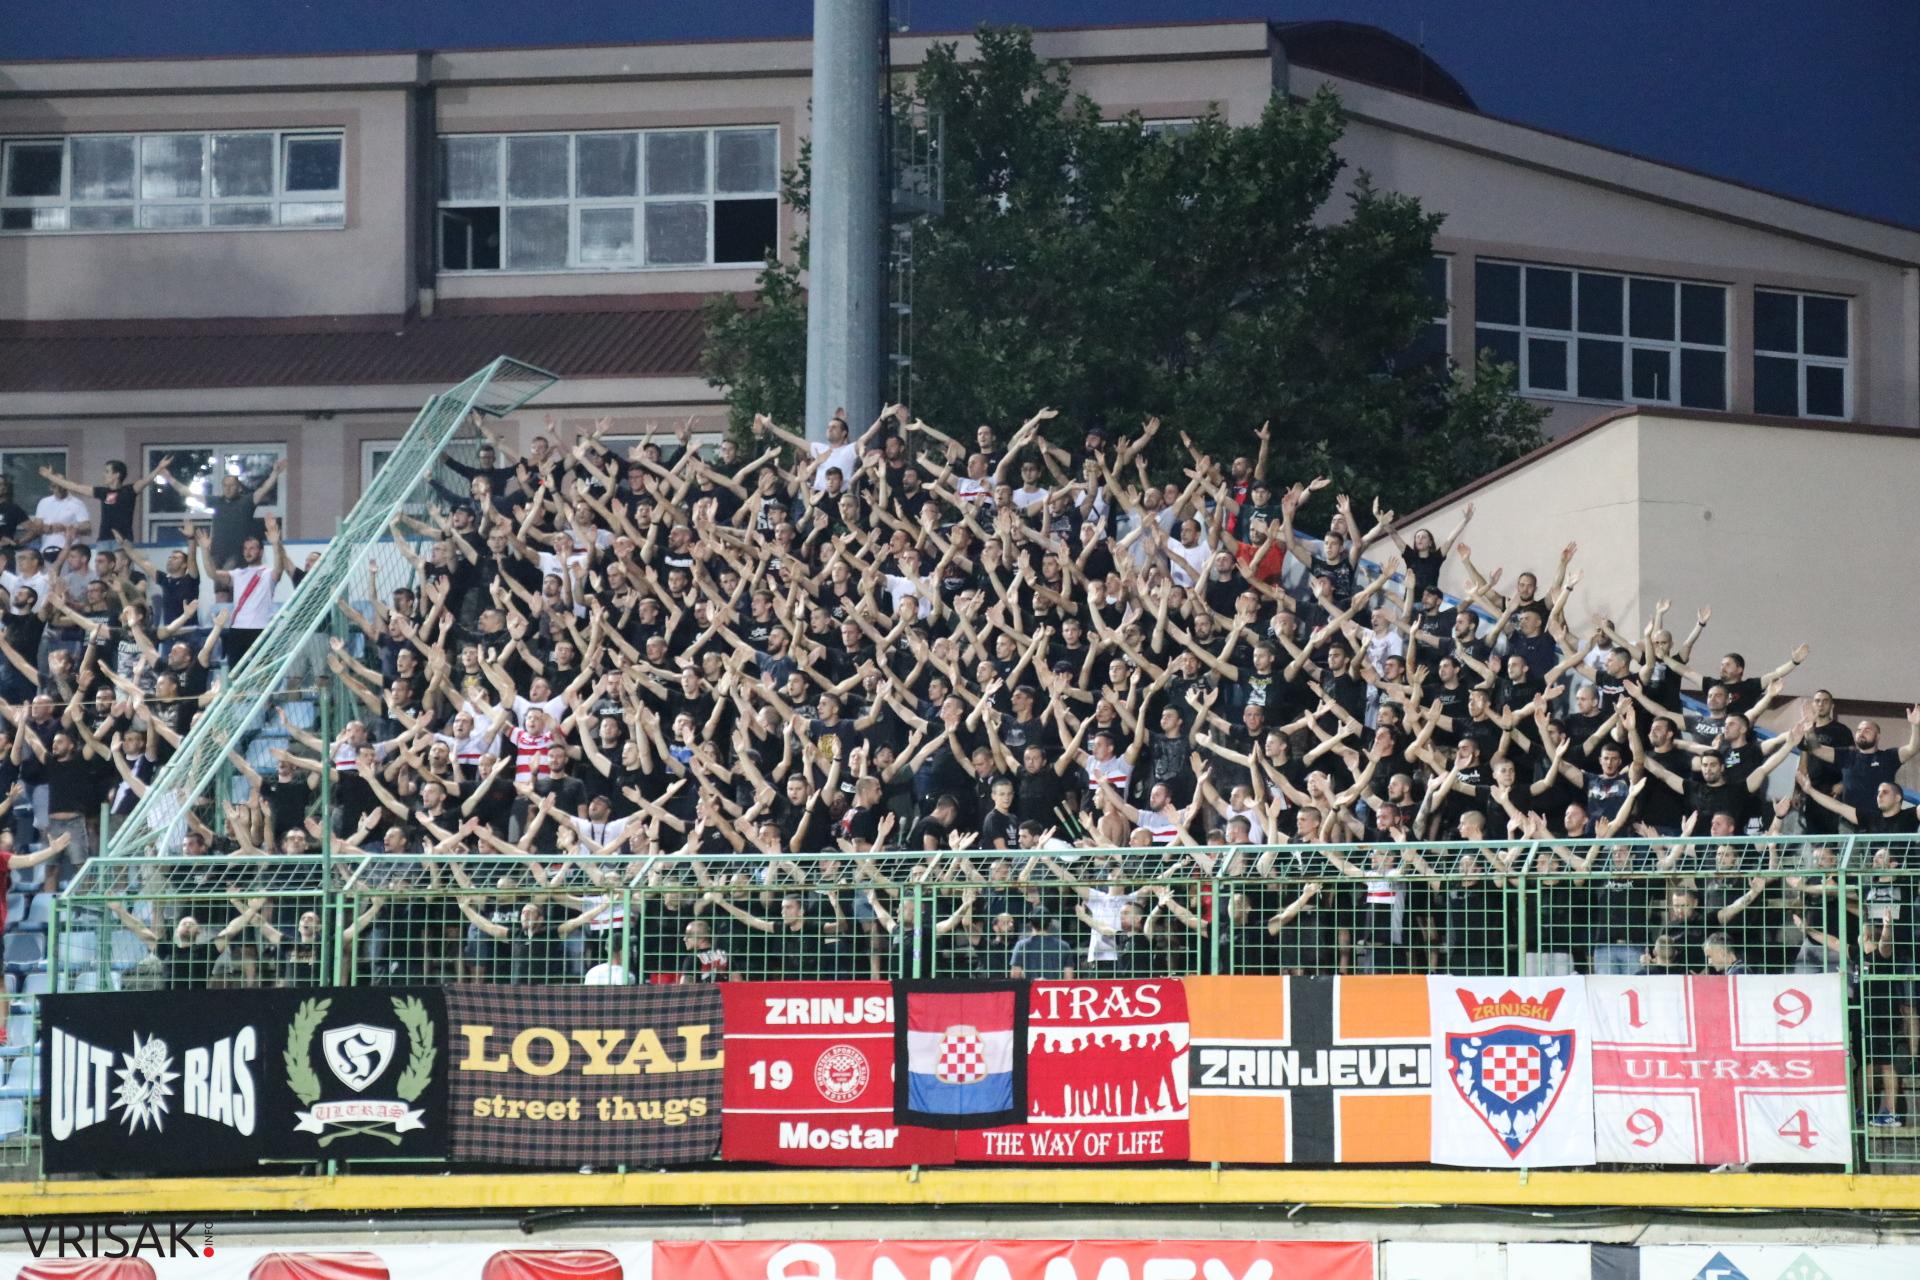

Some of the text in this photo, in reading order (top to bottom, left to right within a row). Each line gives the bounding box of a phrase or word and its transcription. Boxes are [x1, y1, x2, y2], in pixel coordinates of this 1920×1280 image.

[1029, 985, 1162, 1022] TRAS
[1472, 1003, 1549, 1020] ZRINJSKI
[1621, 988, 1648, 1028] 1
[1773, 988, 1812, 1029] 9
[460, 1024, 724, 1076] LOYAL
[749, 1060, 793, 1090] 19
[1200, 1049, 1431, 1086] ZRINJEVCI
[1625, 1059, 1814, 1080] ULTRAS
[315, 1105, 405, 1120] ULTRAS
[473, 1094, 707, 1125] street thugs
[779, 1121, 899, 1149] Mostar
[983, 1129, 1164, 1156] THE WAY OF LIFE
[1626, 1108, 1664, 1148] 9
[1778, 1109, 1819, 1149] 4
